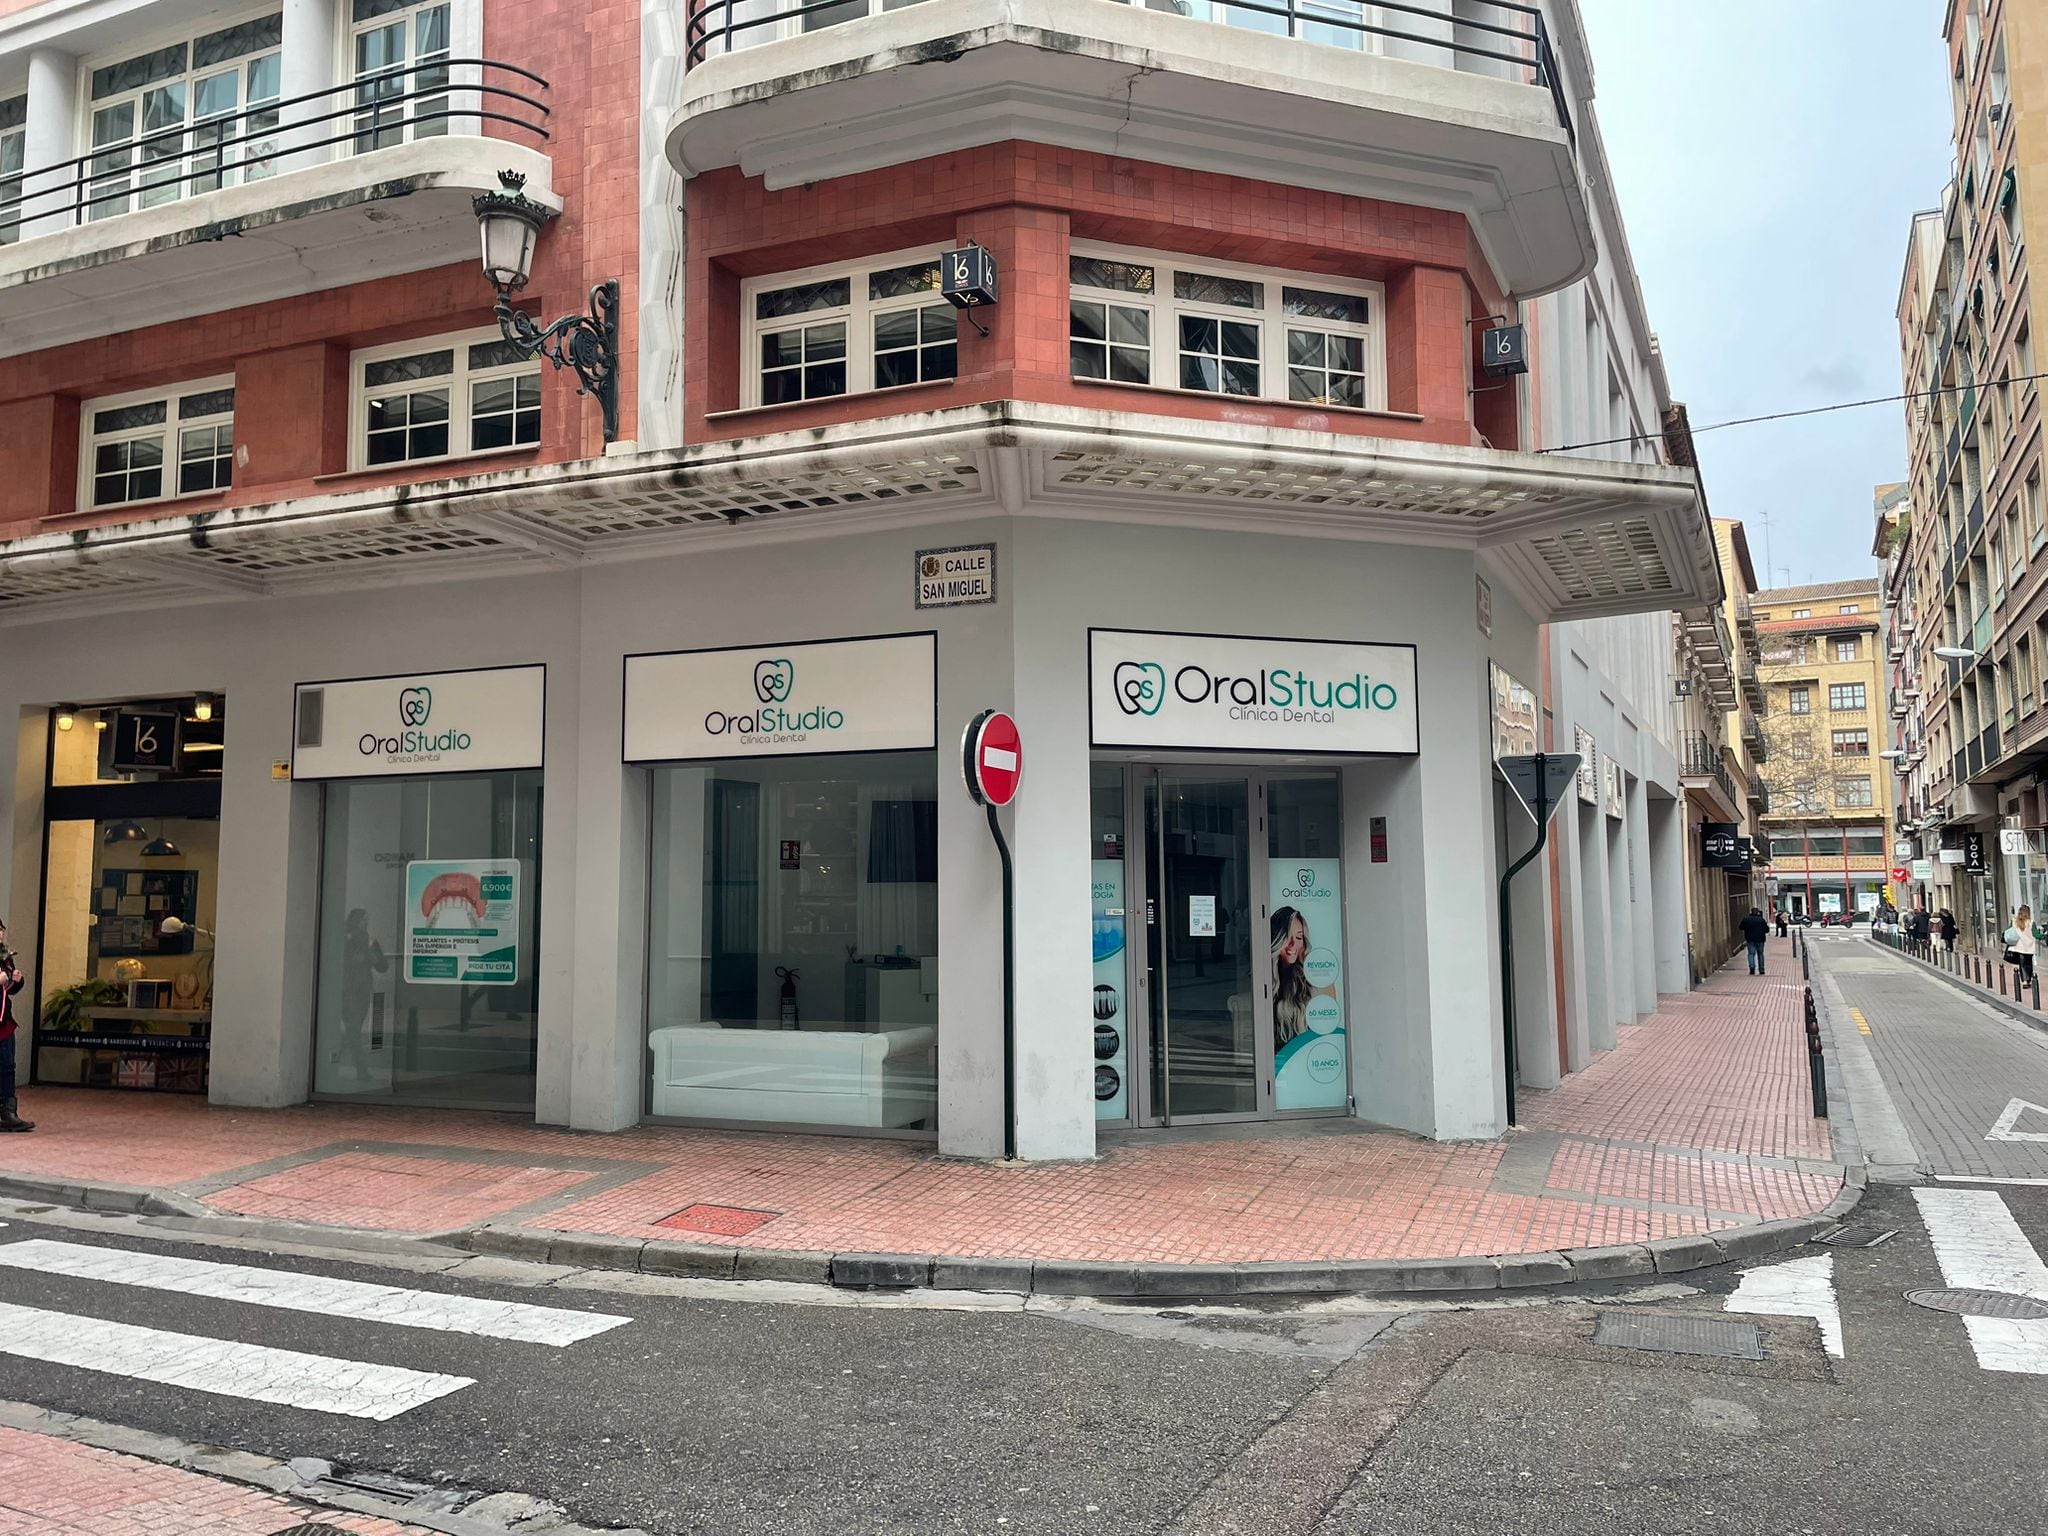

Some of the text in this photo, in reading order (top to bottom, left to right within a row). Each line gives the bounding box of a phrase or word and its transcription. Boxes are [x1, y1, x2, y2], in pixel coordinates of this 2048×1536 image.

[952, 253, 969, 280] 16
[1494, 331, 1511, 354] 16
[945, 556, 985, 573] CALLE
[923, 578, 987, 600] SAN MIGUEL
[1174, 665, 1398, 711] OralStudio
[704, 706, 844, 735] OralStudio
[1229, 706, 1335, 724] Clínica Dental
[133, 716, 157, 753] 16
[359, 729, 471, 755] OralStudio
[740, 733, 807, 745] Clínica Dental
[387, 753, 441, 764] Clínica Dental
[1282, 887, 1332, 898] OralStudio
[1319, 1009, 1337, 1017] MESES
[1311, 1060, 1319, 1068] 10
